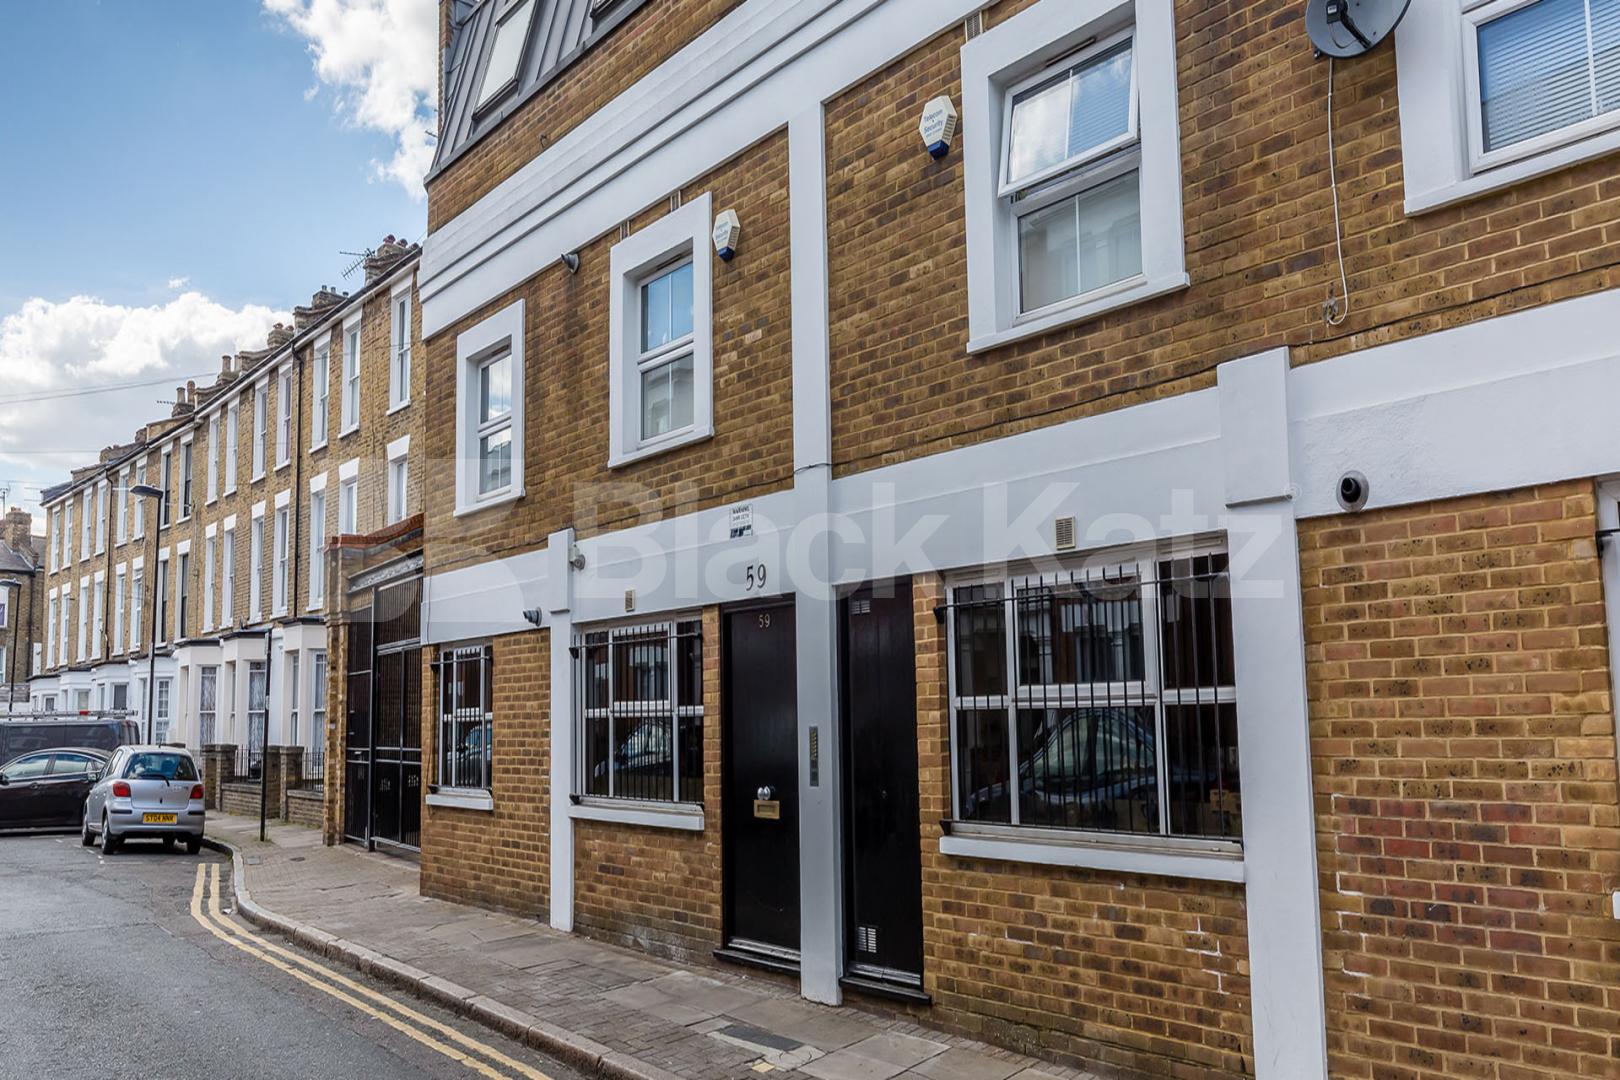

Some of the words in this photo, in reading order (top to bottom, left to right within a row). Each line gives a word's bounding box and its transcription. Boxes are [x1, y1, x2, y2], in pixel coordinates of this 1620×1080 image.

[924, 120, 943, 134] Security
[745, 563, 767, 592] 59
[759, 613, 771, 628] 59
